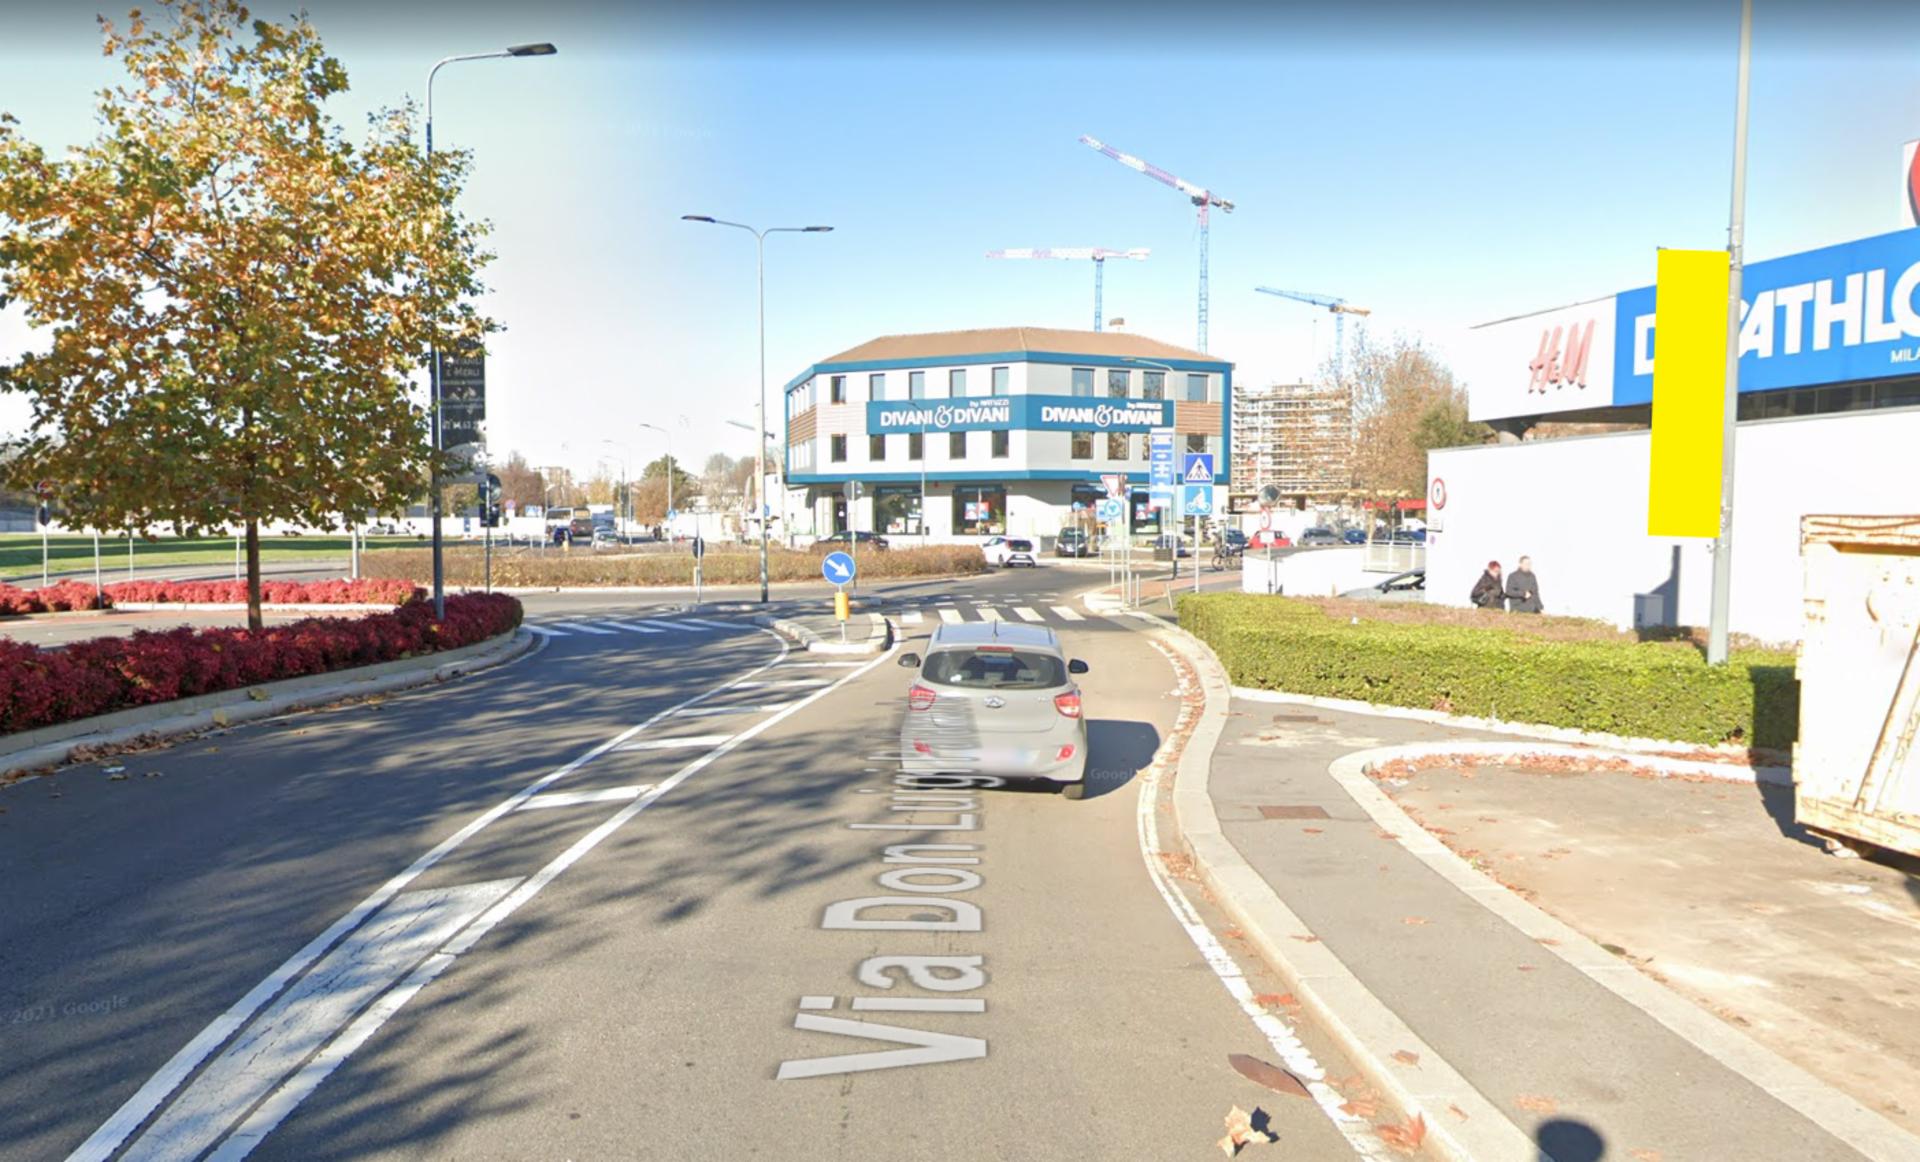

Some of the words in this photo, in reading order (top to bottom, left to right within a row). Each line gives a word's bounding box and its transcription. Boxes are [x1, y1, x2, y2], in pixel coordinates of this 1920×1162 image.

[880, 408, 933, 427] DIVANI
[934, 404, 955, 428] &
[953, 406, 1010, 424] DIVANI
[1041, 406, 1094, 423] DIVANI
[1094, 404, 1113, 428] &
[1113, 408, 1163, 426] DIVANI
